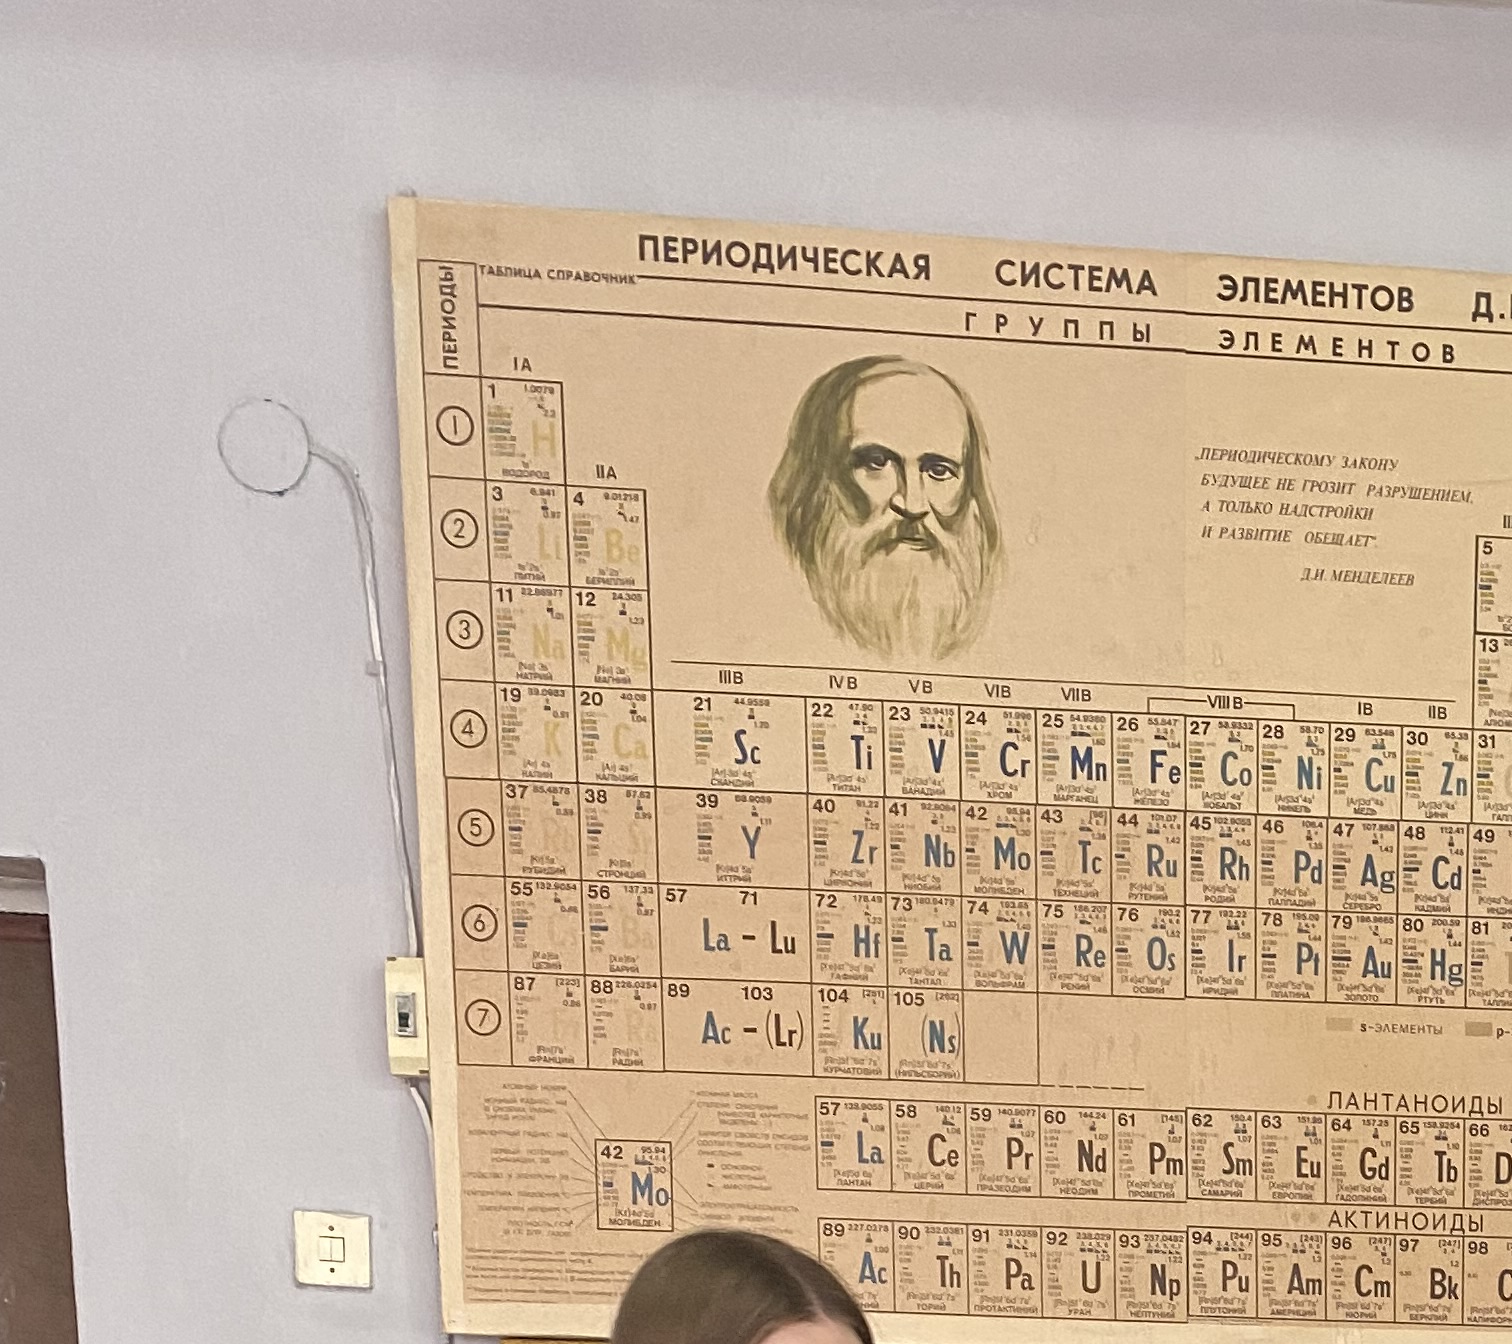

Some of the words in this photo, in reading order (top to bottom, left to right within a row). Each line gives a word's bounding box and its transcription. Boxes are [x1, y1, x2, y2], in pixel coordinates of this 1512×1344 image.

[479, 264, 541, 280] ТАБЛИЦА
[546, 268, 638, 284] СПРАВОЧНИК
[638, 234, 931, 281] ПЕРИОДИЧЕСКАЯ
[995, 259, 1159, 298] СИСТЕМА
[1216, 274, 1415, 314] ЭЛЕМЕНТОВ
[441, 265, 460, 371] ПЕРИОДЫ
[451, 416, 459, 438] 1
[1341, 456, 1399, 471] ЗАКОНУ
[1201, 473, 1271, 490] БУДУЩЕЕ
[1276, 478, 1295, 491] НЕ
[1302, 479, 1355, 495] ГРОЗИТ
[1201, 501, 1210, 512] А
[1218, 500, 1273, 515] ТОЛЬКО
[1279, 502, 1374, 521] НАДСТРОЙКИ
[451, 518, 466, 540] 2
[1202, 525, 1212, 538] И
[1219, 526, 1292, 542] РАЗВИТИЕ
[1331, 570, 1415, 587] МЕНДЕЛЕЕВ
[458, 619, 472, 642] 3
[461, 717, 474, 738] 4
[734, 729, 761, 766] Sc
[851, 735, 873, 771] Ti
[928, 738, 946, 774] V
[999, 741, 1030, 778] Cr
[1071, 746, 1107, 783] Mn
[1150, 749, 1180, 785] Fe
[1220, 752, 1252, 787] Co
[1298, 755, 1322, 791] Ni
[1365, 758, 1395, 794] Cu
[1440, 761, 1467, 797] Zn
[469, 817, 482, 837] 5
[741, 825, 761, 860] Y
[851, 830, 878, 865] Zr
[924, 833, 955, 870] Nb
[994, 836, 1031, 872] Mo
[1079, 840, 1103, 874] Tc
[1147, 844, 1177, 879] Ru
[1219, 847, 1250, 882] Rh
[1294, 849, 1322, 884] Pd
[1361, 853, 1395, 893] Ag
[1433, 855, 1462, 891] Cd
[666, 888, 687, 904] 57
[739, 890, 758, 906] 71
[473, 913, 485, 934] 6
[702, 918, 731, 953] La
[770, 920, 796, 955] Lu
[853, 925, 882, 959] Hf
[924, 927, 951, 963] Ta
[1000, 931, 1030, 965] W
[1075, 934, 1106, 968] Re
[1147, 936, 1176, 971] Os
[1229, 939, 1246, 973] Ir
[1296, 942, 1319, 976] Pt
[1362, 945, 1392, 979] Au
[1430, 948, 1463, 986] Hg
[668, 983, 690, 1000] 89
[741, 985, 774, 1001] 103
[476, 1008, 489, 1029] 7
[701, 1011, 731, 1046] Ac
[766, 1010, 804, 1049] (Lr)
[853, 1016, 882, 1051] Ku
[920, 1016, 960, 1053] (Ns)
[1328, 1091, 1503, 1114] ЛАНТАНОИДЫ
[600, 1145, 623, 1160] 42
[857, 1130, 884, 1164] La
[928, 1133, 960, 1167] Ce
[1006, 1138, 1034, 1171] Pr
[1078, 1140, 1106, 1173] Nd
[1149, 1142, 1184, 1176] Pm
[1222, 1141, 1253, 1176] Sm
[1297, 1147, 1322, 1178] Eu
[1359, 1148, 1390, 1181] Gd
[1434, 1150, 1458, 1184] Tb
[632, 1171, 670, 1206] Mo
[1328, 1211, 1485, 1233] АКТИНОИДЫ
[859, 1251, 888, 1284] Ac
[936, 1255, 961, 1288] Th
[1006, 1258, 1035, 1291] Pa
[1081, 1261, 1101, 1293] U
[1150, 1263, 1181, 1300] Np
[1222, 1261, 1250, 1293] Pu
[1287, 1264, 1322, 1295] Am
[1355, 1264, 1390, 1299] Cm
[1429, 1268, 1459, 1300] Bk
